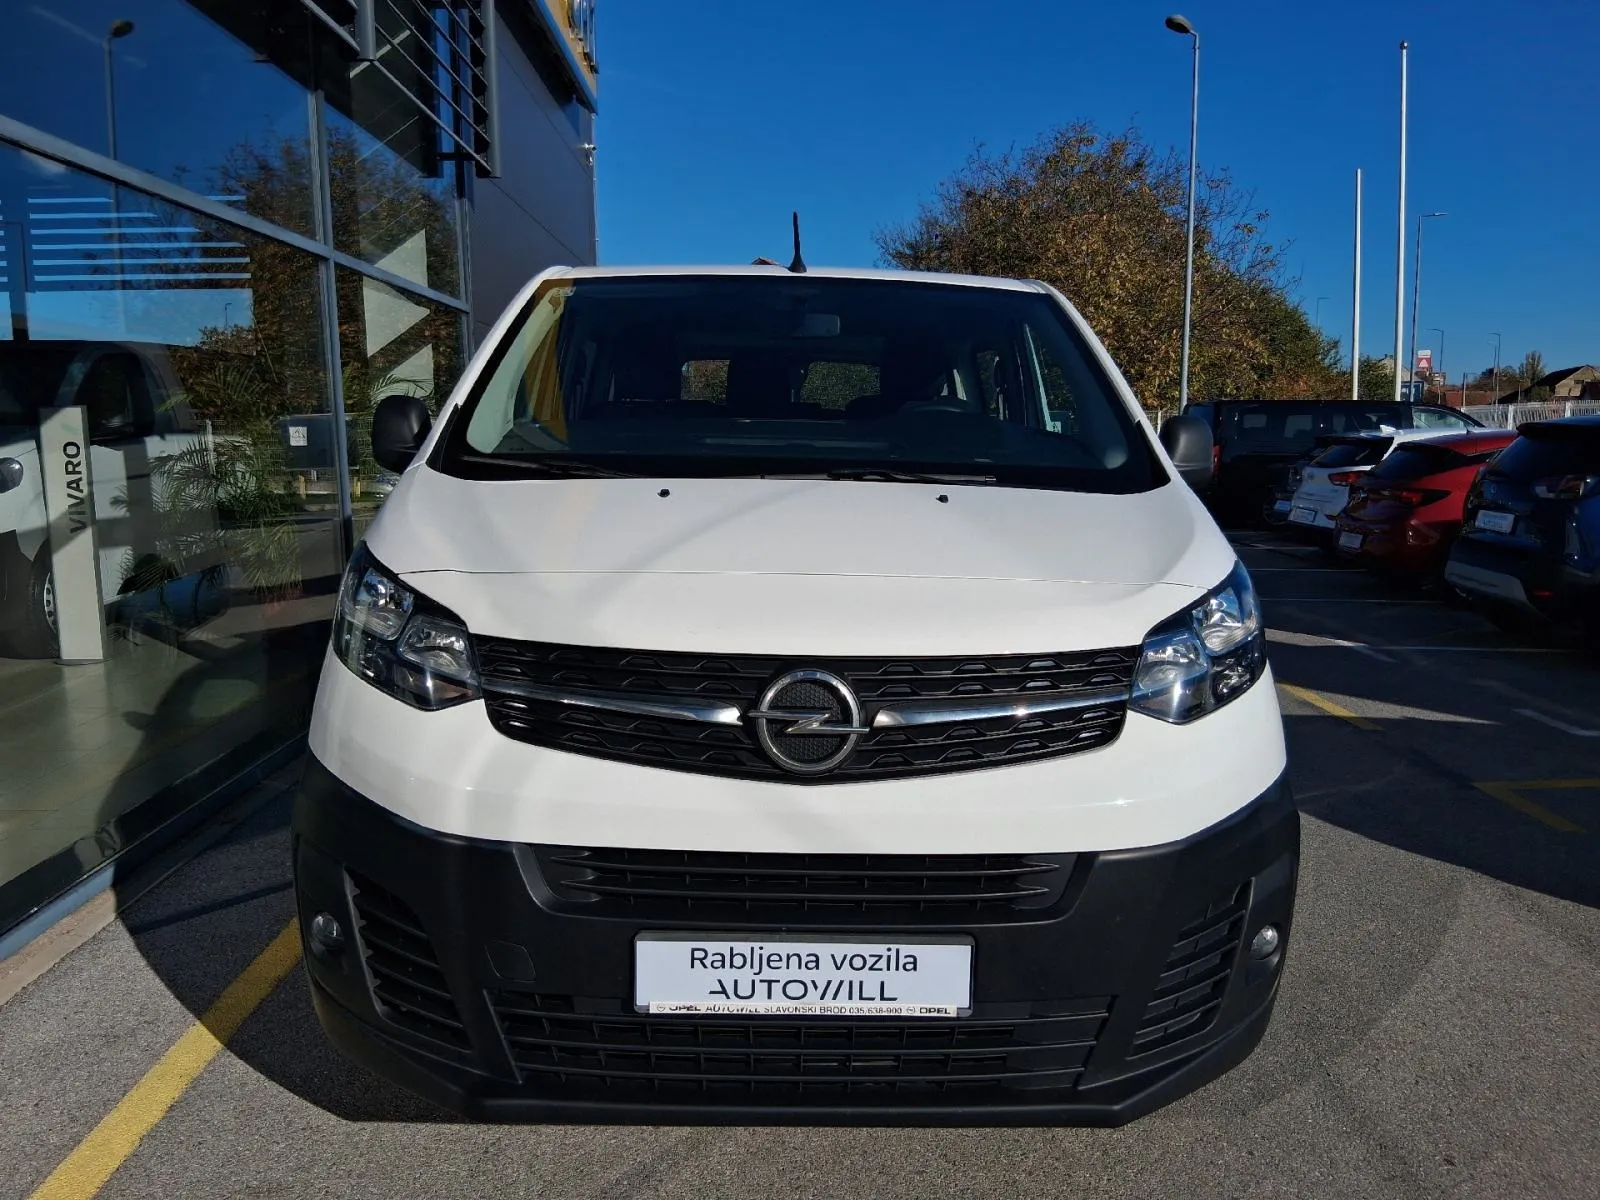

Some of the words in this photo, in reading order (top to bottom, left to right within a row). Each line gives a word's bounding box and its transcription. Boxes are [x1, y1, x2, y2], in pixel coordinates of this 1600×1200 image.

[63, 441, 88, 534] VIVARO
[690, 946, 820, 975] Rabljena
[831, 947, 919, 972] vozila
[763, 1005, 817, 1014] SLAVONSKI
[819, 1006, 847, 1014] BROD
[919, 1006, 951, 1015] OPEL
